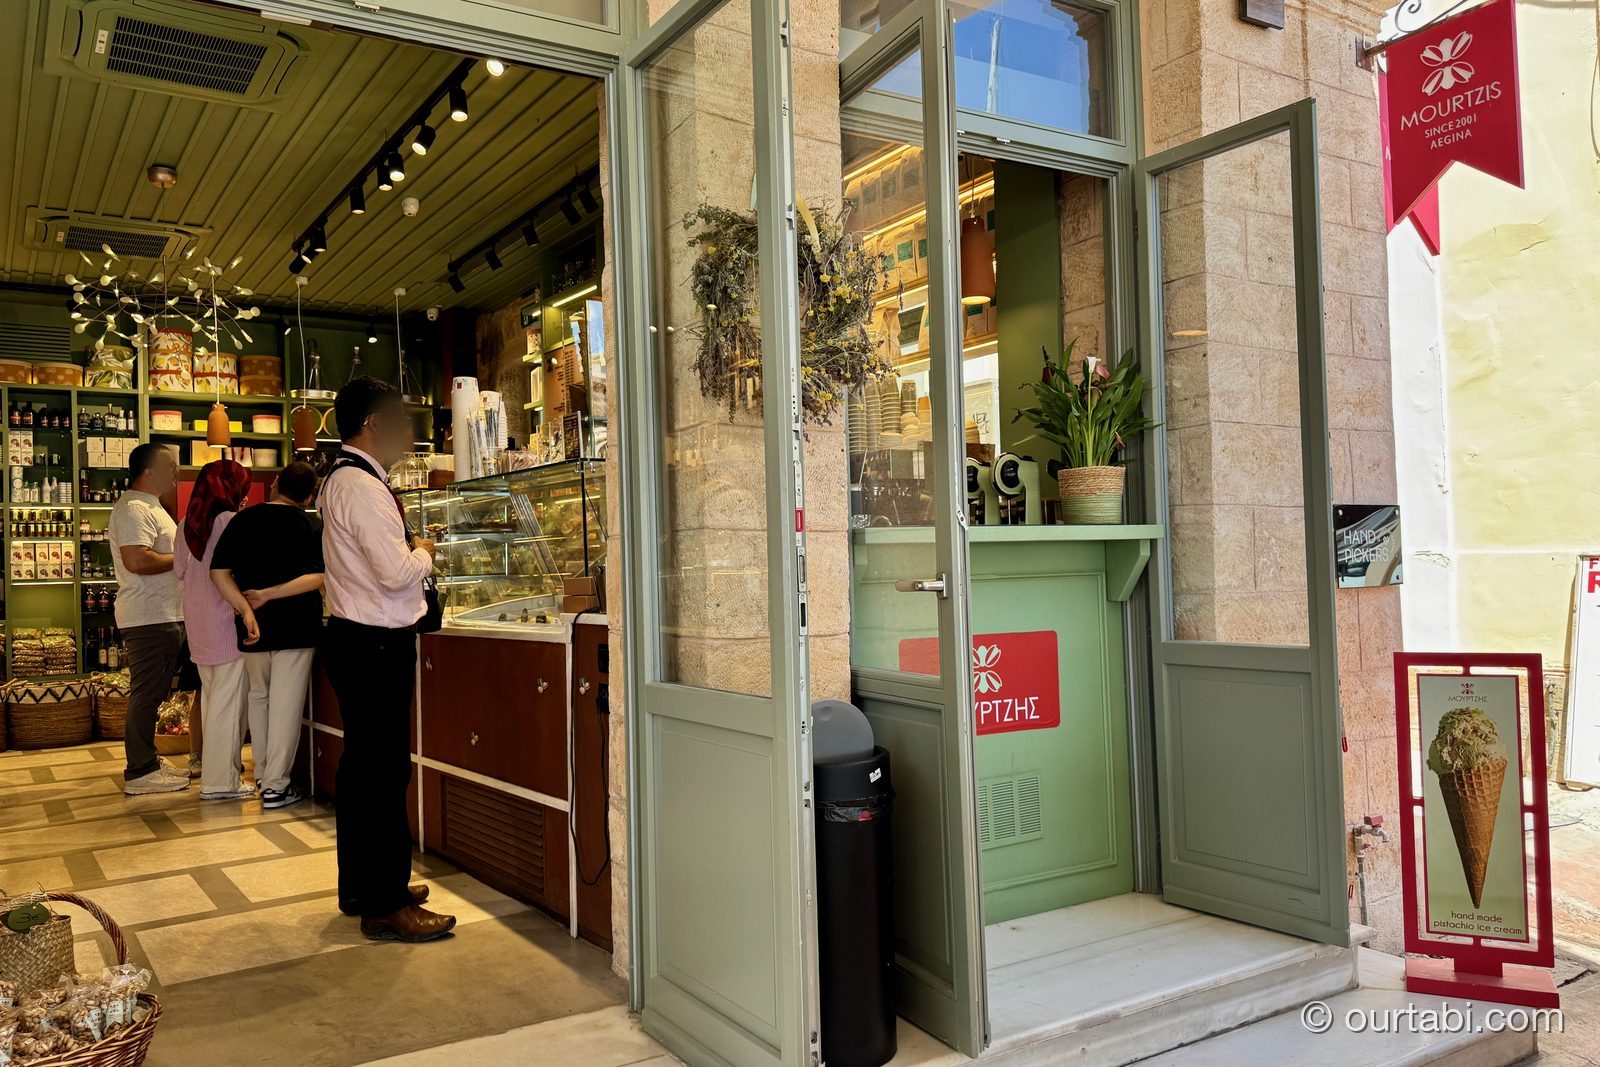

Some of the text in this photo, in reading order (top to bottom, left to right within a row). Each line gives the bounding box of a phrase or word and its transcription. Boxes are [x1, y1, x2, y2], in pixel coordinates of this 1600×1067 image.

[1400, 81, 1502, 131] MOURTZIS
[1424, 113, 1477, 139] SINCE 2001
[1430, 128, 1472, 150] AEGINA
[1343, 529, 1376, 545] HAND
[1344, 547, 1389, 563] PICKERS
[974, 696, 1040, 725] ΡΤΖΗΣ
[1451, 910, 1503, 923] hand made
[1433, 920, 1523, 935] pistachio ice cream
